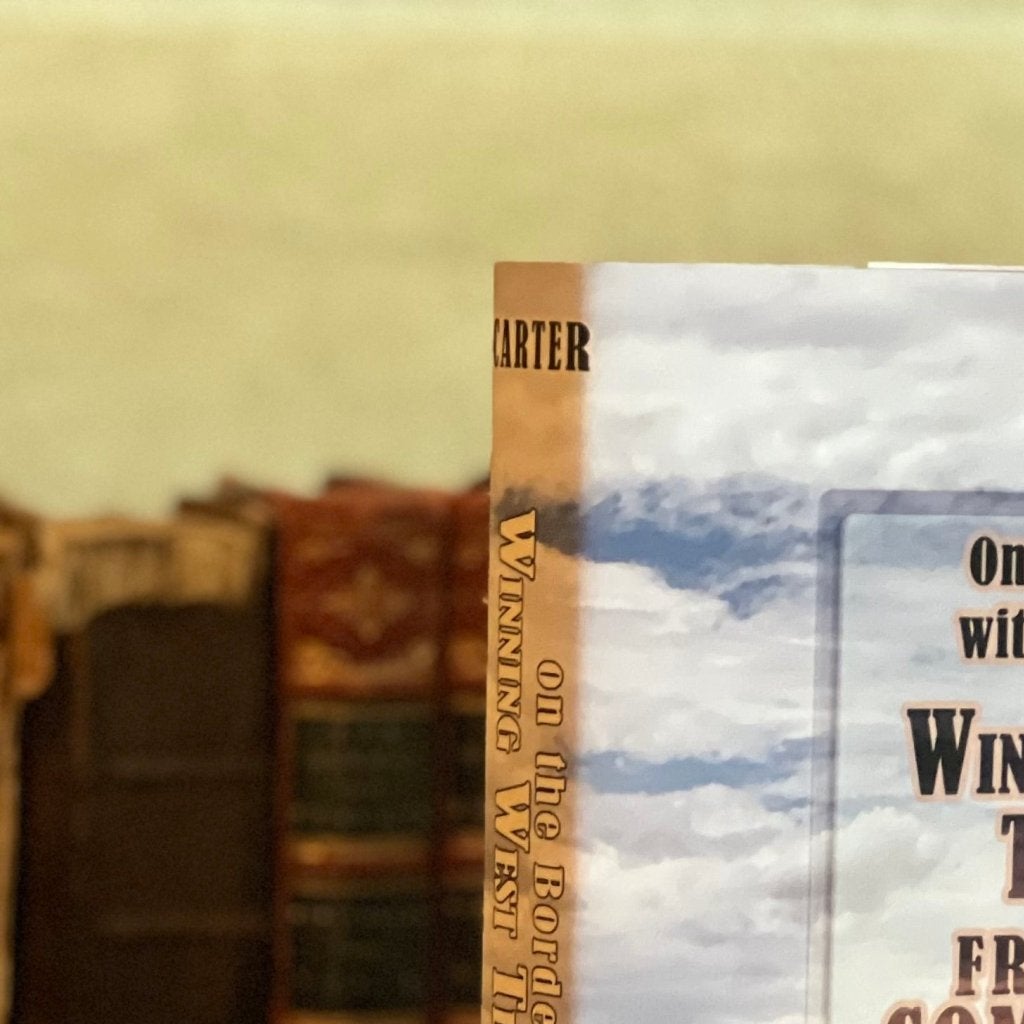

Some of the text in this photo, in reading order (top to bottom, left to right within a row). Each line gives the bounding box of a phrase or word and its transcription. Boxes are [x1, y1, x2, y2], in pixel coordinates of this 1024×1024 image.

[494, 318, 590, 372] CARTER
[495, 508, 537, 753] WINNING
[533, 752, 567, 840] the
[493, 780, 532, 939] WEST
